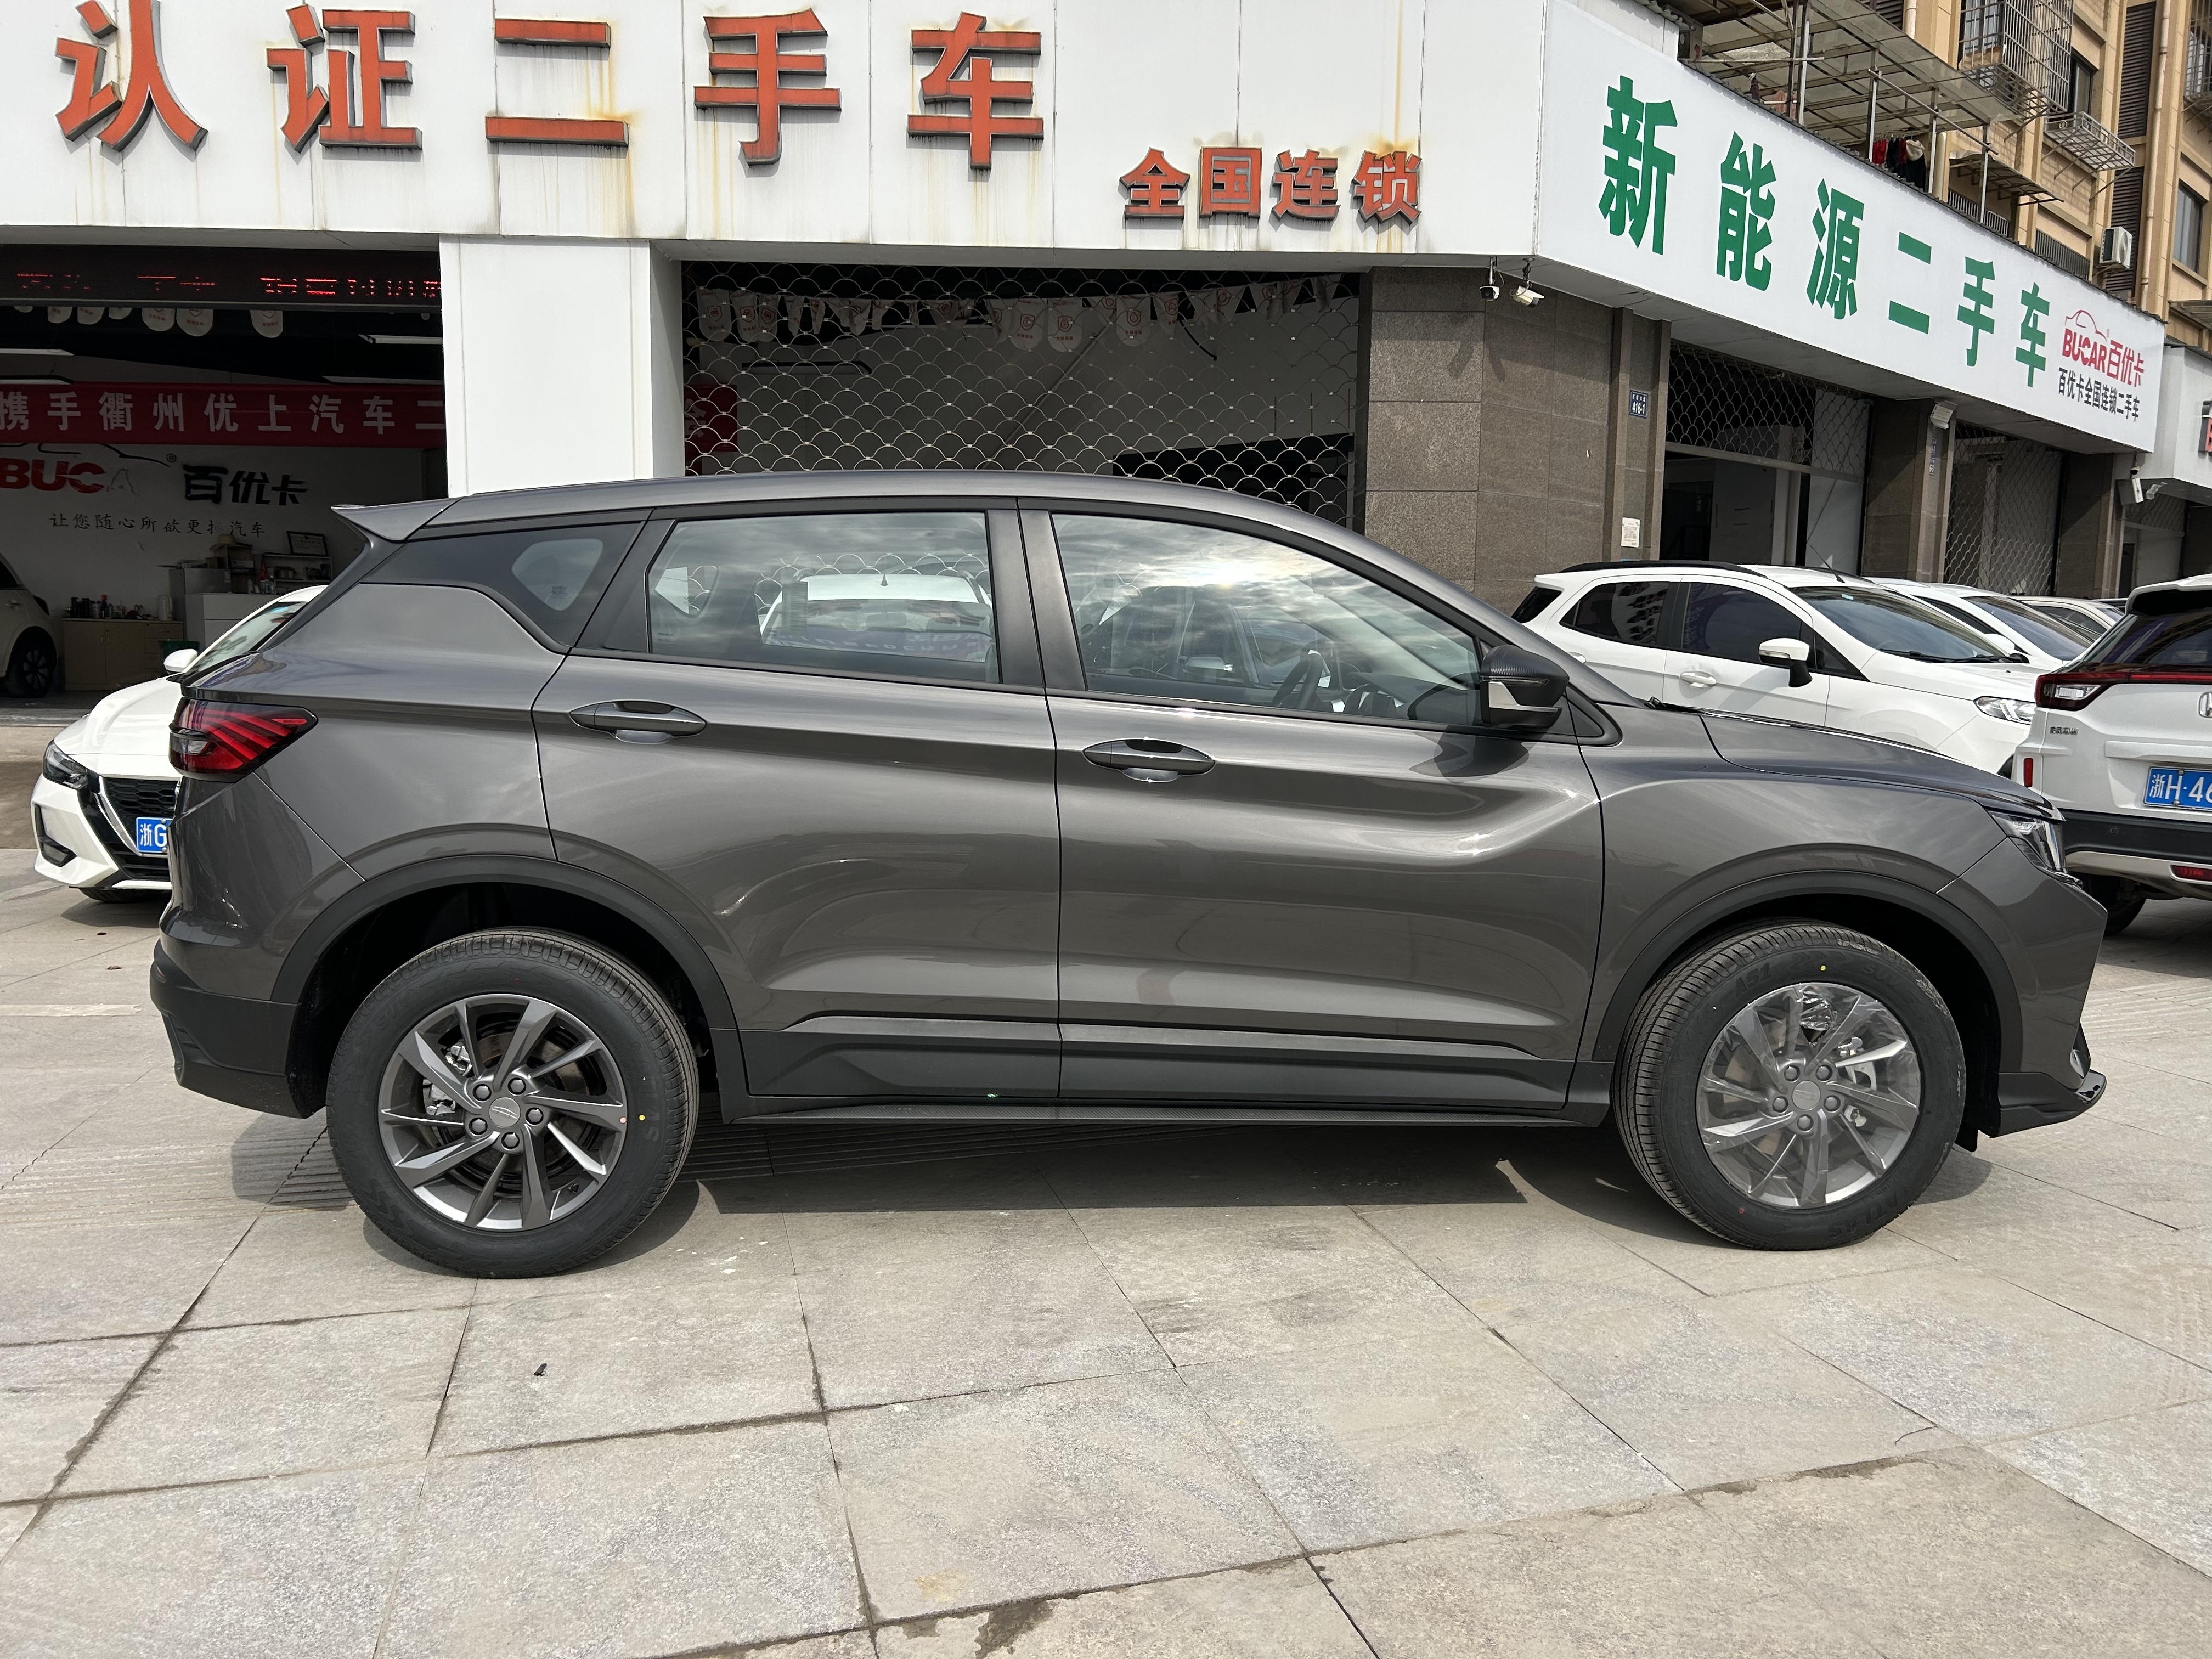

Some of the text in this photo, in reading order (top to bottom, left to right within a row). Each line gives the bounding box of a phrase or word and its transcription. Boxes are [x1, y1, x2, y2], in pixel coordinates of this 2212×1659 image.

[55, 0, 1044, 170] 认证二手车
[1119, 146, 1423, 225] 全国连锁
[1598, 75, 2050, 387] 新能源二手车
[2062, 328, 2145, 388] BUCAR 百优卡
[2058, 366, 2141, 422] 百优卡全国连锁二手车
[183, 464, 308, 506] 百优卡
[140, 823, 167, 848] 浙G
